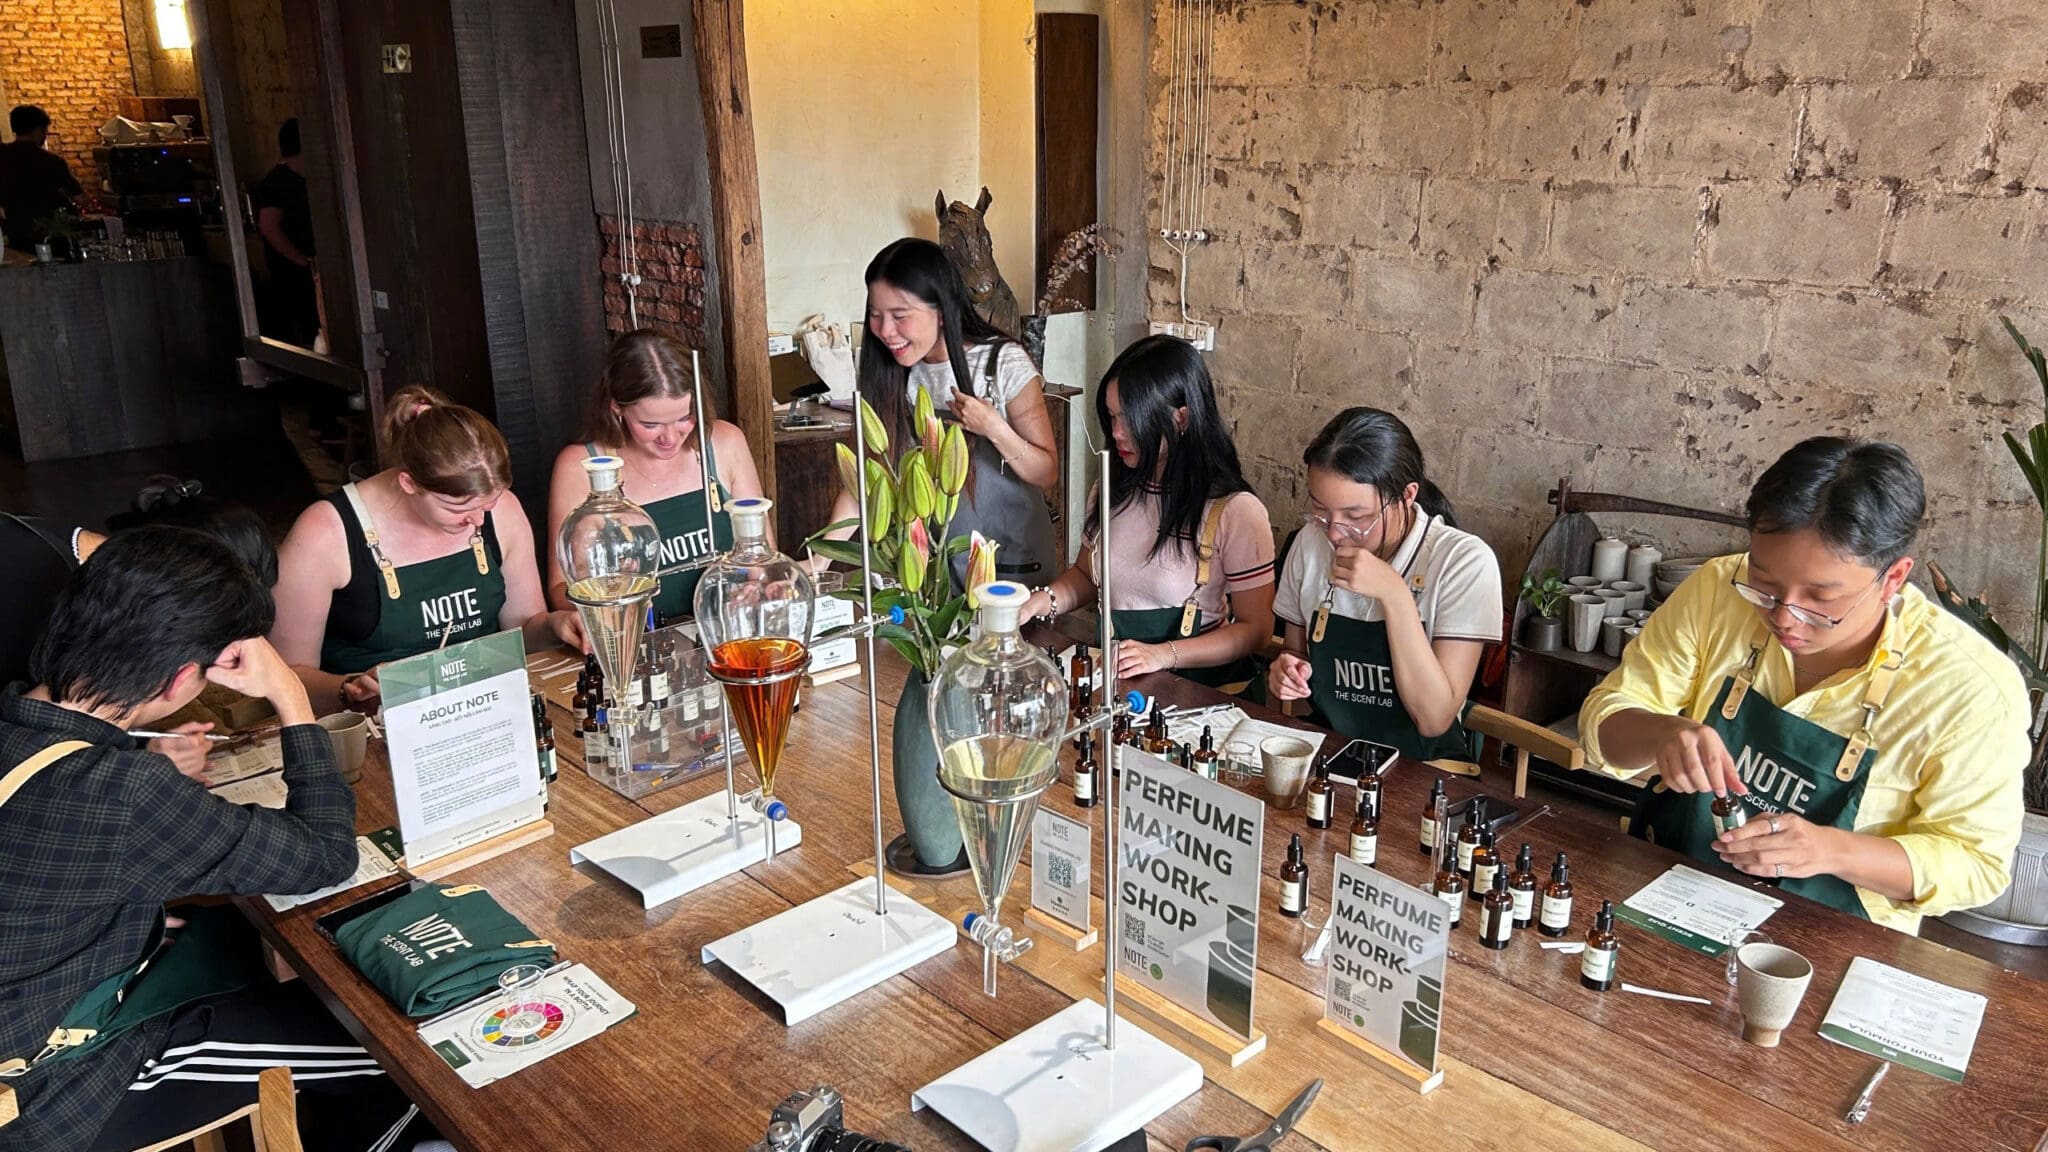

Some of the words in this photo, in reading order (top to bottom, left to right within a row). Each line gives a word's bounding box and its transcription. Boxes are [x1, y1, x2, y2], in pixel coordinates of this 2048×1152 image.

[660, 528, 709, 565] NOTE
[421, 588, 480, 627] NOTE
[425, 629, 441, 640] THE
[468, 618, 482, 629] LAB
[440, 659, 467, 676] NOTE
[1334, 658, 1393, 694] NOTE
[419, 700, 464, 724] ABOUT
[466, 690, 499, 709] NOTE
[1334, 690, 1349, 701] THE
[1351, 693, 1376, 705] SCENT
[1377, 699, 1393, 707] LAB
[1736, 744, 1817, 814] NOTE
[1123, 767, 1255, 846] PERFUME
[1745, 791, 1779, 815] SCENT
[1052, 821, 1068, 838] NOTE
[1123, 806, 1233, 876] MAKING
[1123, 842, 1219, 906] WORK-
[1121, 880, 1197, 932] SHOP
[1338, 871, 1442, 934] PERFUME
[398, 913, 473, 959] NOTE
[1336, 899, 1424, 955] MAKING
[392, 940, 413, 955] SCENT
[405, 953, 424, 967] LAB
[1124, 946, 1148, 970] NOTE
[1335, 925, 1411, 975] WORK-
[1332, 952, 1393, 994] SHOP
[1332, 1001, 1352, 1019] NOTE
[1849, 1022, 1907, 1050] FORMULA
[1910, 1047, 1944, 1062] YOUR
